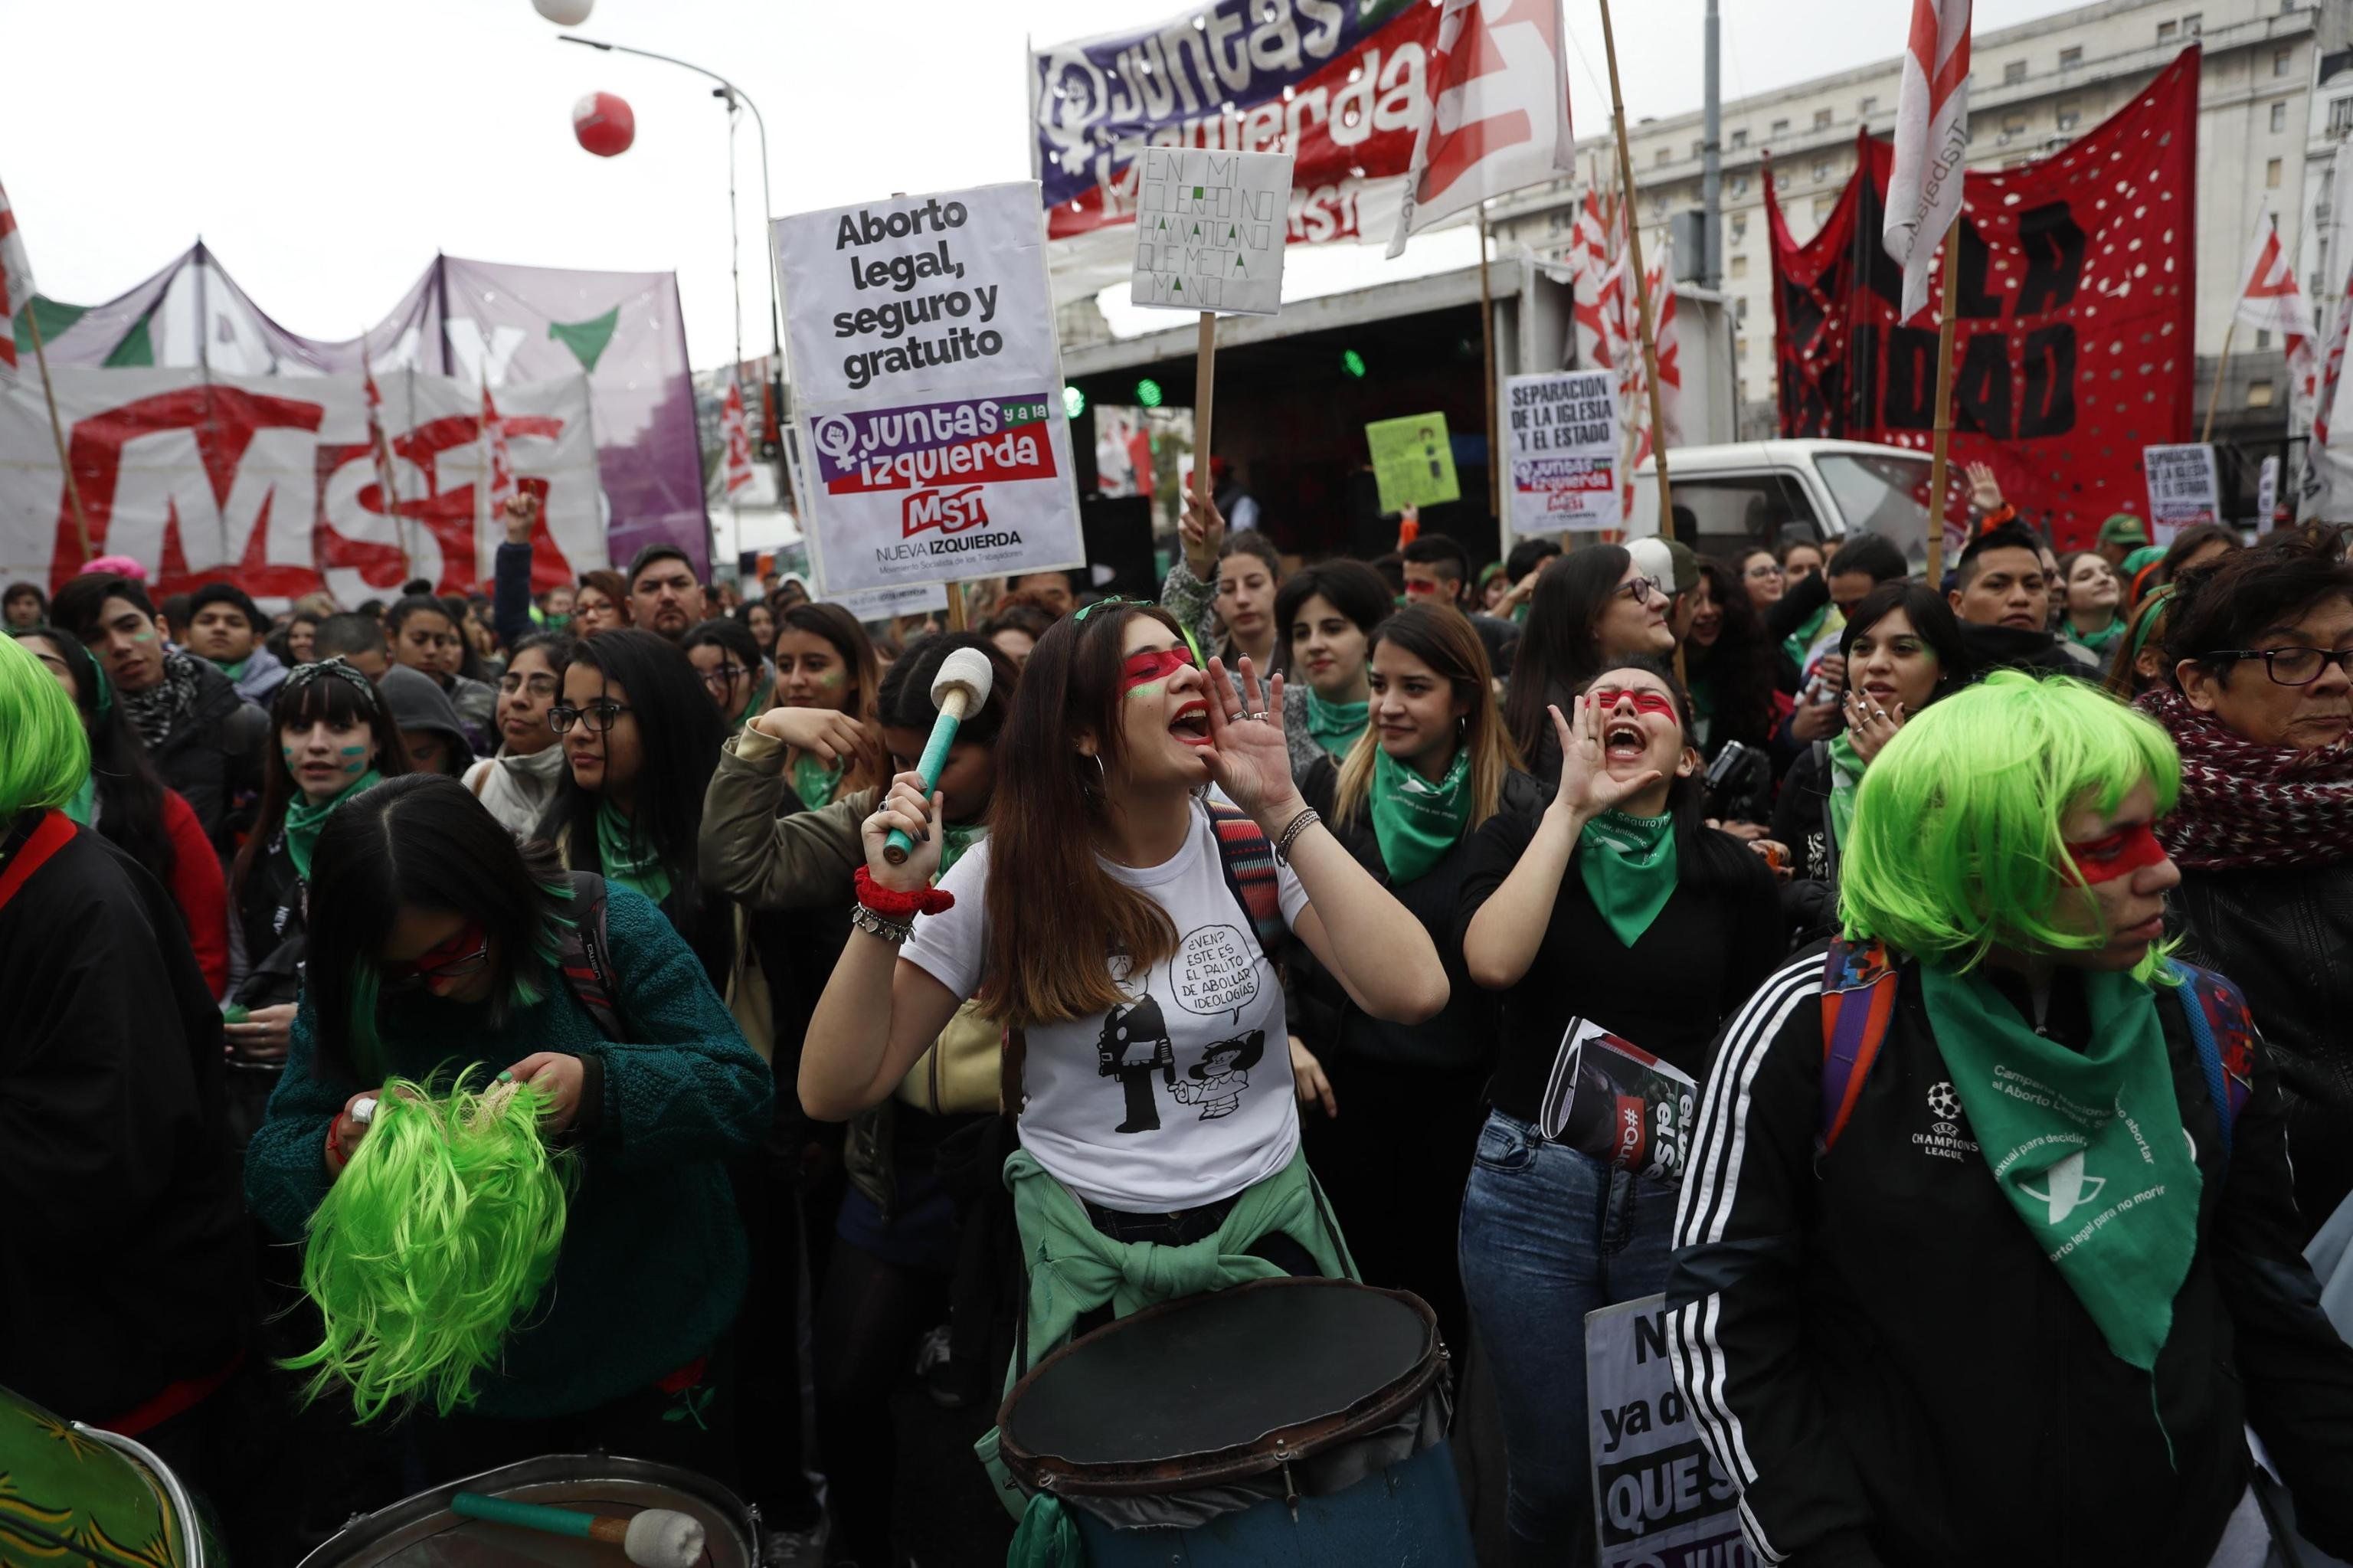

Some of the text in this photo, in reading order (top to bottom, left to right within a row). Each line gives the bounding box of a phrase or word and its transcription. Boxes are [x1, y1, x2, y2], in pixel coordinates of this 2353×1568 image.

[1147, 149, 1184, 182] EN
[1144, 183, 1275, 222] CUERPO NO
[836, 198, 968, 250] Aborto
[1140, 214, 1270, 251] HAY VATICANO
[850, 240, 965, 293] legal,
[1137, 243, 1180, 274] QUE
[1152, 273, 1222, 306] MANO
[833, 284, 999, 339] seguro y
[843, 326, 1003, 390] gratuito
[1003, 408, 1014, 423] y
[1017, 405, 1027, 420] a
[1032, 403, 1048, 418] la
[1511, 400, 1613, 430] DE LA IGLESIA
[1517, 422, 1611, 452] Y EL ESTADO
[84, 406, 568, 609] MST
[905, 489, 987, 535] MST
[875, 530, 1023, 563] NUEVA IZQUIERDA
[879, 550, 1024, 574] Movimiento Socialista de los Trabajadores
[1187, 943, 1234, 966] ESTE ES
[1188, 931, 1225, 951] ¿VEN?
[1181, 967, 1251, 997] DE ABOLLAR
[1186, 969, 1200, 980] EL
[1194, 982, 1255, 1009] IDEOLOGÍAS
[1991, 1080, 2003, 1091] al
[2004, 1084, 2050, 1107] Aborto
[1912, 1133, 1979, 1152] CHAMPIONS
[1932, 1123, 1958, 1136] UEFA
[2019, 1136, 2046, 1157] para
[2046, 1132, 2089, 1147] decidir,
[2125, 1117, 2155, 1166] abortar
[1925, 1146, 1962, 1160] LEAGUE
[2049, 1184, 2166, 1262] orto legal para no morir
[1601, 1380, 1690, 1452] ya d
[1607, 1454, 1736, 1534] QUE S
